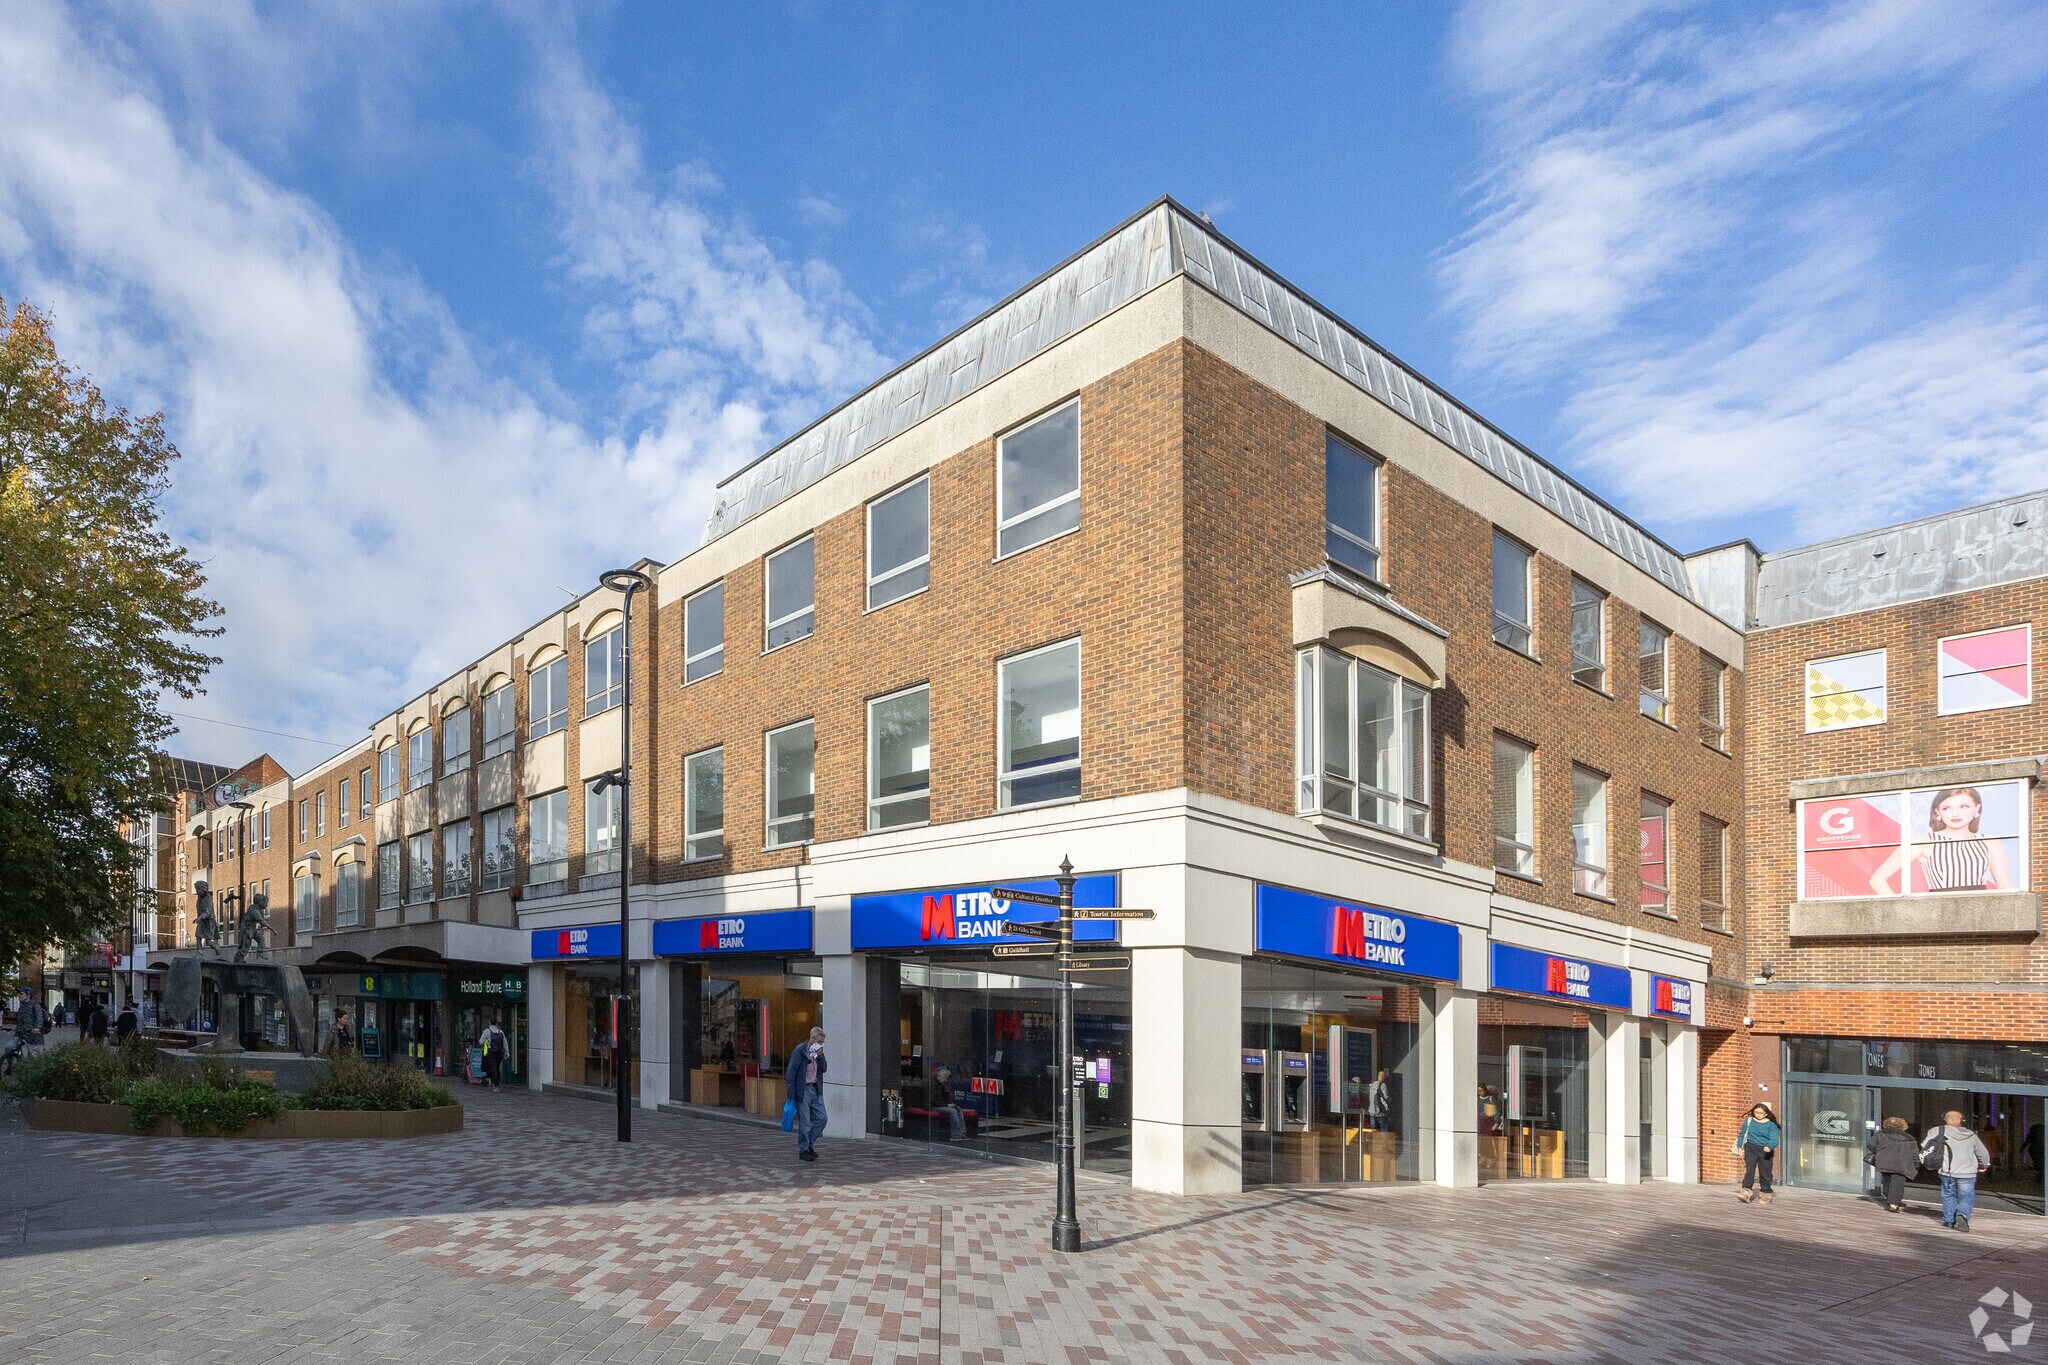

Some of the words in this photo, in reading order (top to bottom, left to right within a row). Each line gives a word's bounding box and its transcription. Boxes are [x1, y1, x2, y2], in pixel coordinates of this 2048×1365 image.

[1819, 806, 1854, 835] G
[1816, 834, 1862, 843] GROSVENOR
[1015, 893, 1034, 901] Cultural
[1035, 895, 1053, 904] Quarter
[921, 892, 1011, 940] METRO
[558, 929, 588, 955] METRO
[700, 918, 745, 949] METRO
[719, 936, 744, 948] BANK
[1332, 906, 1406, 959] METRO
[570, 945, 588, 954] BANK
[1365, 942, 1405, 966] BANK
[1547, 957, 1590, 994] METRO
[461, 980, 483, 993] Holland
[1566, 982, 1590, 998] BANK
[1656, 979, 1691, 1012] METRO
[1672, 1000, 1691, 1015] BANK
[1867, 1052, 1884, 1068] ONES
